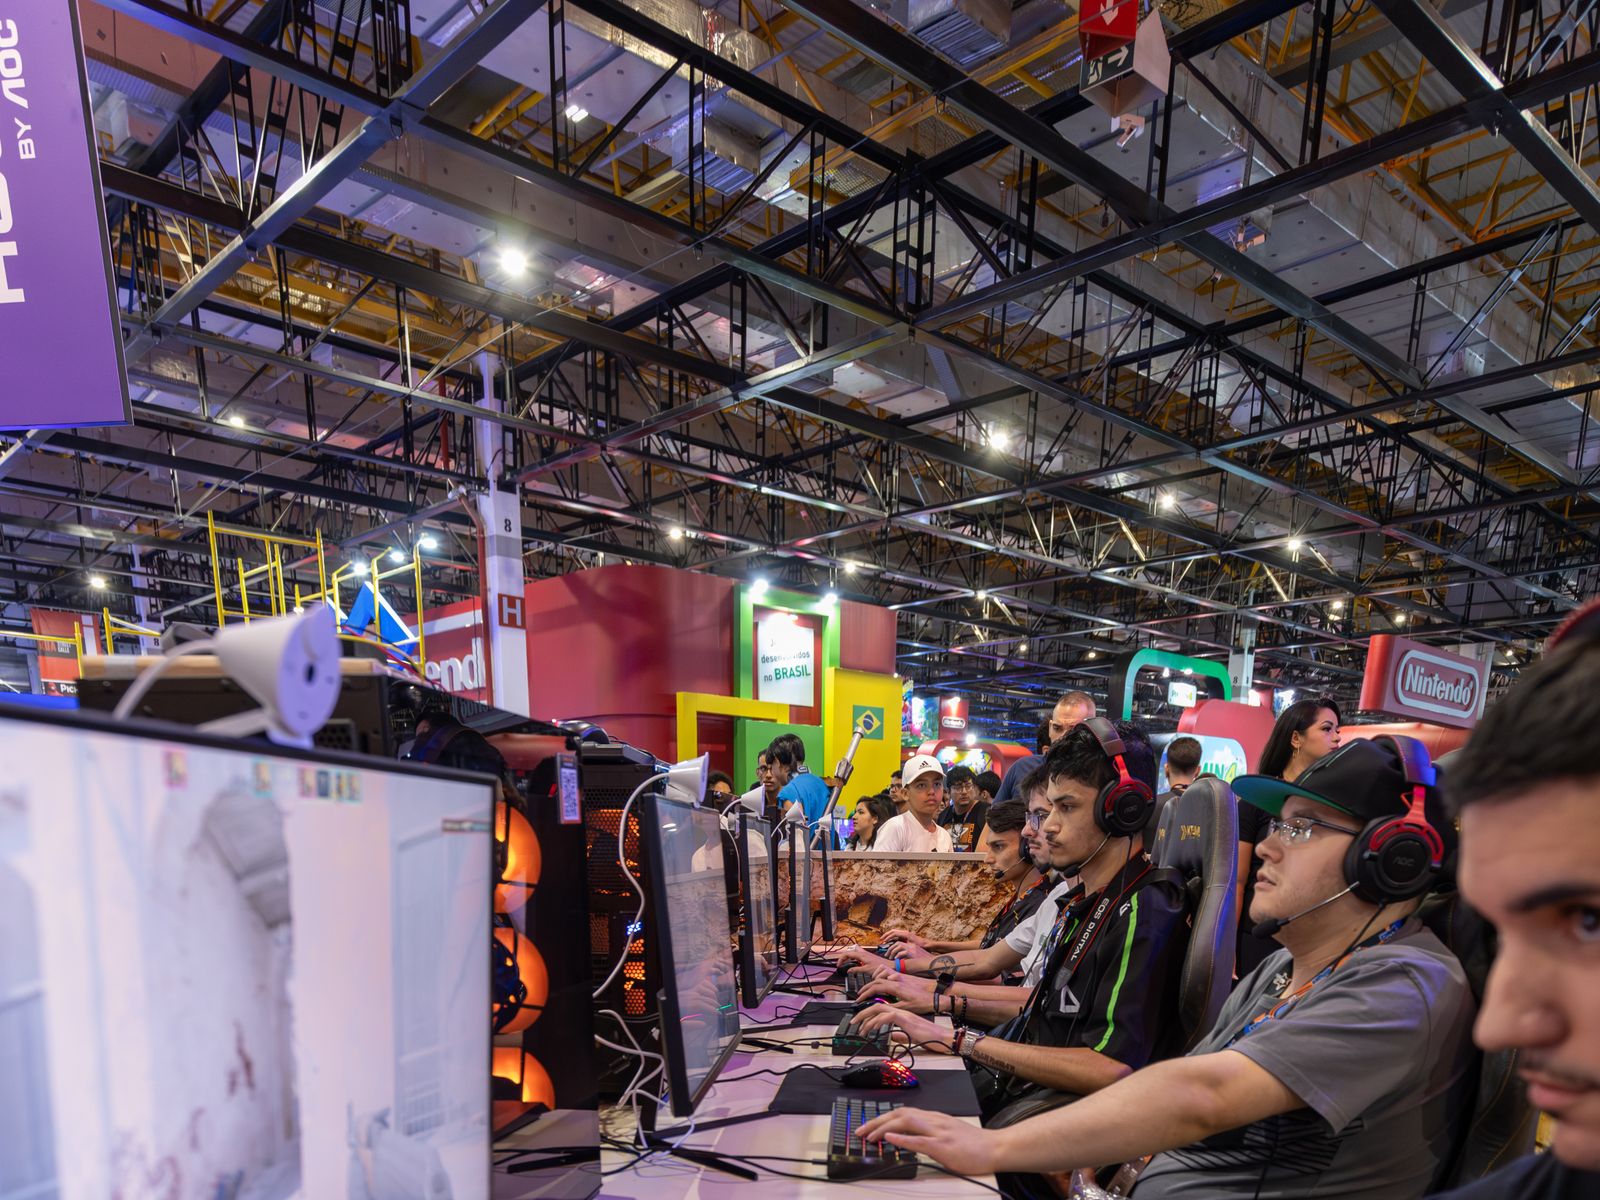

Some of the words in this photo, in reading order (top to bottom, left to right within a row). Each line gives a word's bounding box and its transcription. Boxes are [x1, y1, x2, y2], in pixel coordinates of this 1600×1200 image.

[14, 117, 36, 160] BY
[503, 518, 513, 533] 8
[502, 596, 522, 627] H
[764, 674, 773, 682] no
[774, 664, 812, 681] BRASIL
[1405, 663, 1472, 706] Nintendo
[1093, 897, 1110, 920] EOS
[1070, 921, 1096, 961] DIGITAL
